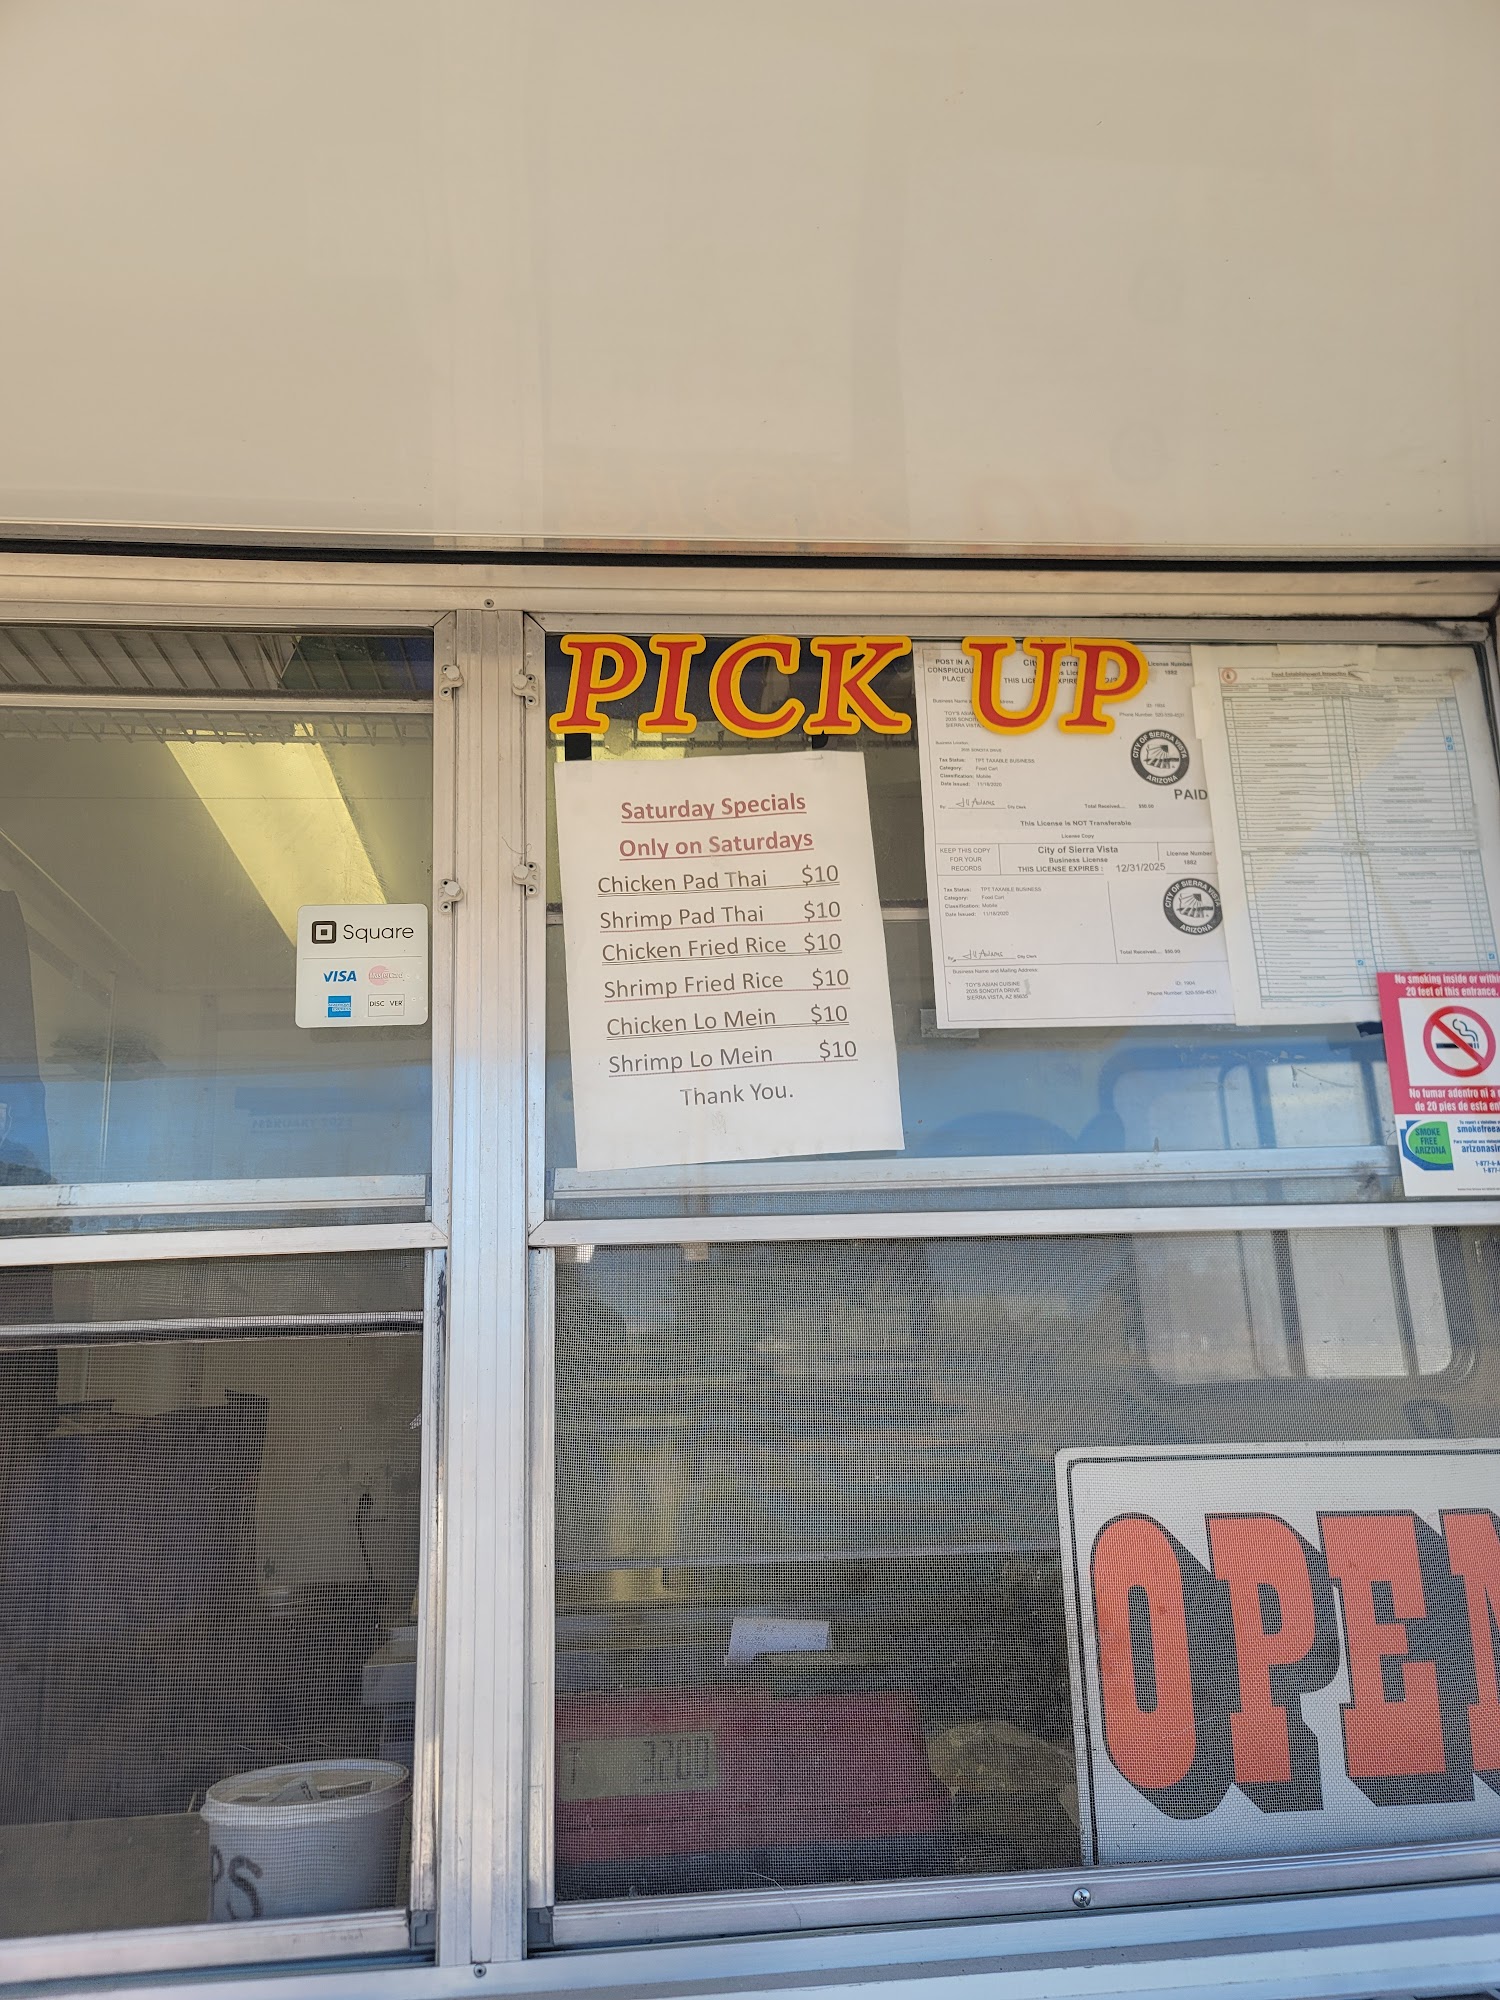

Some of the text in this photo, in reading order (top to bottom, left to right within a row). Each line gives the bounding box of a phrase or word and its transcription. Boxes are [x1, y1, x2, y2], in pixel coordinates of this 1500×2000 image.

[549, 634, 1149, 738] PICK UP
[1132, 731, 1188, 759] CITY OF SIERRA VISTA
[1146, 774, 1179, 784] ARIZONA
[1173, 789, 1208, 800] PAID
[621, 793, 806, 820] Saturday Specials
[619, 831, 814, 860] Only on Saturdays
[1038, 846, 1055, 855] City
[1096, 845, 1119, 853] Vista
[1116, 862, 1165, 873] 12/31/2025
[598, 864, 839, 893] Chicken Pad Thai $10
[1164, 880, 1221, 908] CITY OF SIERRA VISTA
[600, 900, 841, 931] Shrimp Pad Thai $10
[343, 924, 414, 943] Square
[1180, 924, 1213, 934] ARIZONA
[602, 932, 841, 962] Chicken Fried Rice $10
[323, 970, 357, 983] VISA
[1394, 974, 1406, 984] No
[1407, 974, 1442, 985] smoking
[1443, 974, 1468, 984] inside
[1469, 975, 1477, 984] or
[604, 968, 849, 1000] Shrimp Fried Rice $10
[1406, 987, 1499, 996] 20 feet of this entrance.
[607, 1003, 848, 1035] Chicken Lo Mein $10
[609, 1039, 857, 1074] Shrimp Lo Mein $10
[680, 1083, 794, 1106] Thank You.
[1409, 1088, 1496, 1099] No fumar adentro ni a
[1415, 1101, 1488, 1112] de 20 pies de esta
[1415, 1128, 1440, 1136] SMOKE
[1457, 1125, 1500, 1133] smokefreea
[1420, 1137, 1437, 1145] FREE
[1415, 1146, 1446, 1154] ARIZONA
